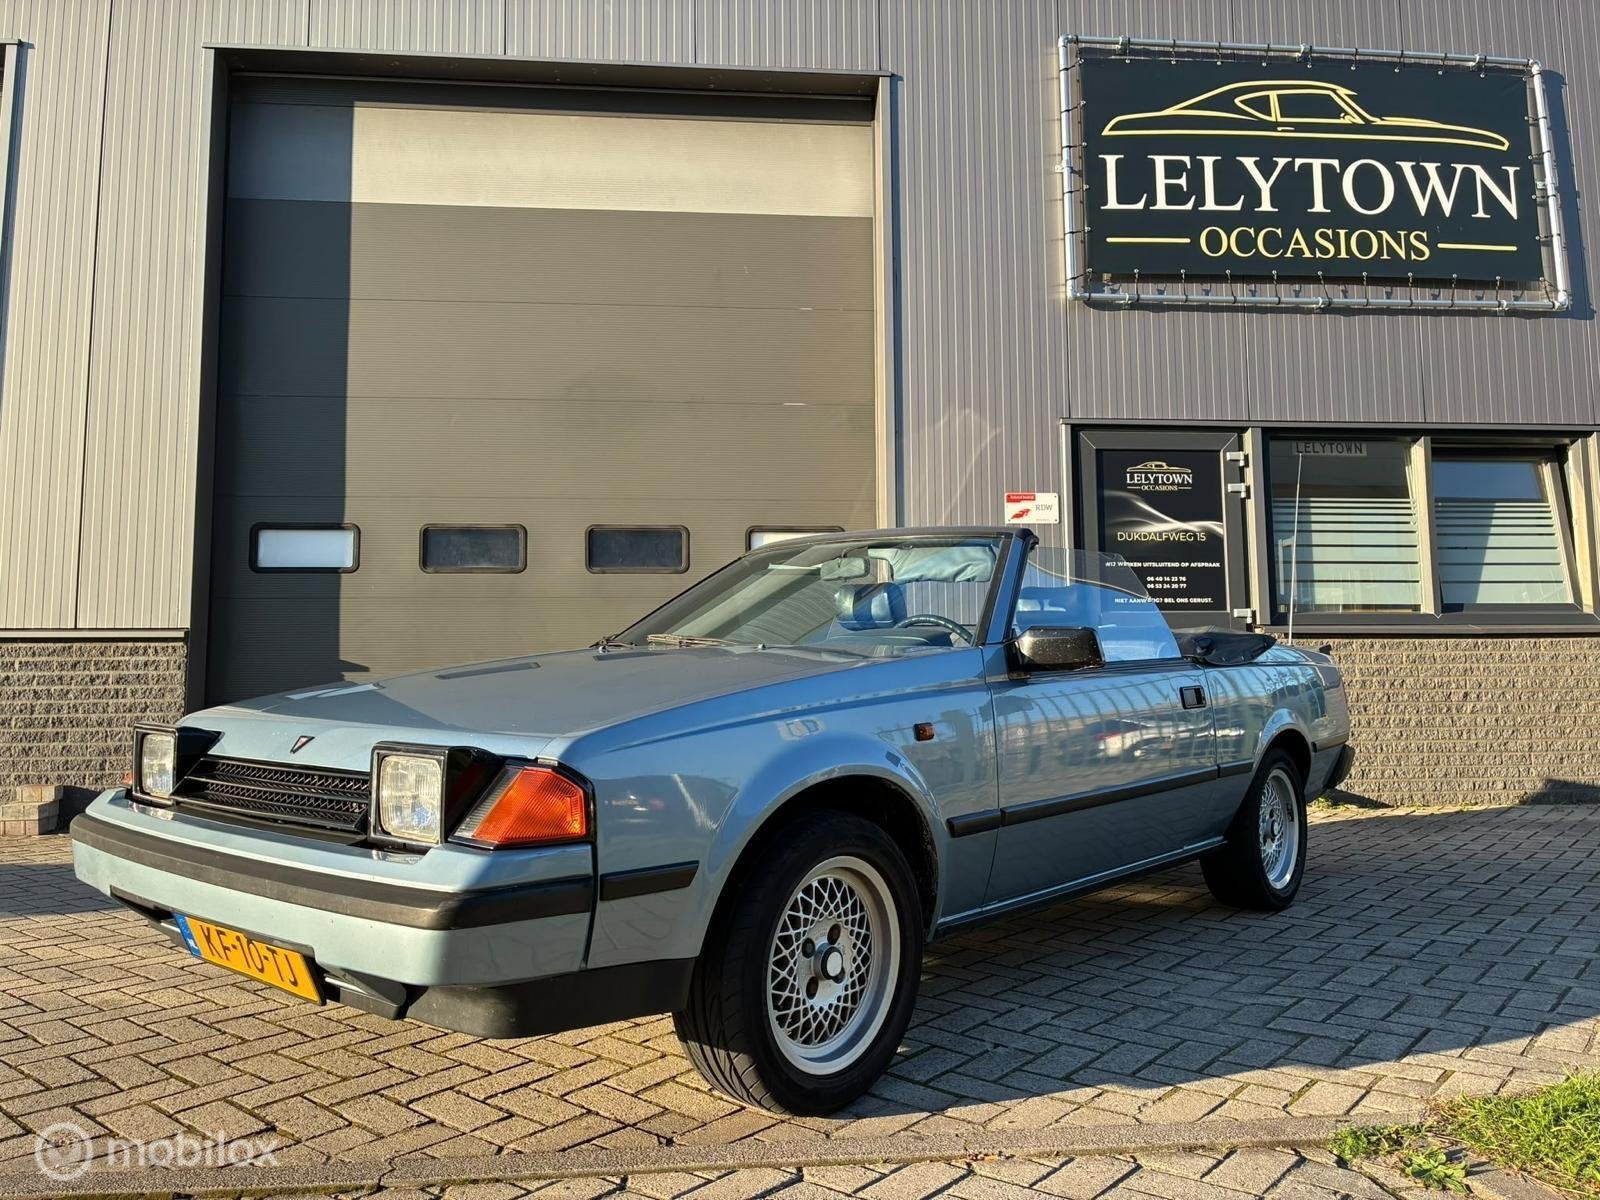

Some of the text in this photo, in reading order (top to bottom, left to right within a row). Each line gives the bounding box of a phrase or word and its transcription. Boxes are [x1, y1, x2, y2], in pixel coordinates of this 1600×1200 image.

[1098, 154, 1521, 220] LELYTOWN
[1199, 226, 1430, 262] OCCASIONS
[1295, 441, 1363, 454] LELYTOWN
[1126, 473, 1193, 485] LELYTOWN
[1117, 531, 1207, 542] DUKDALFWEG 15
[200, 924, 298, 987] KF-10-TJ
